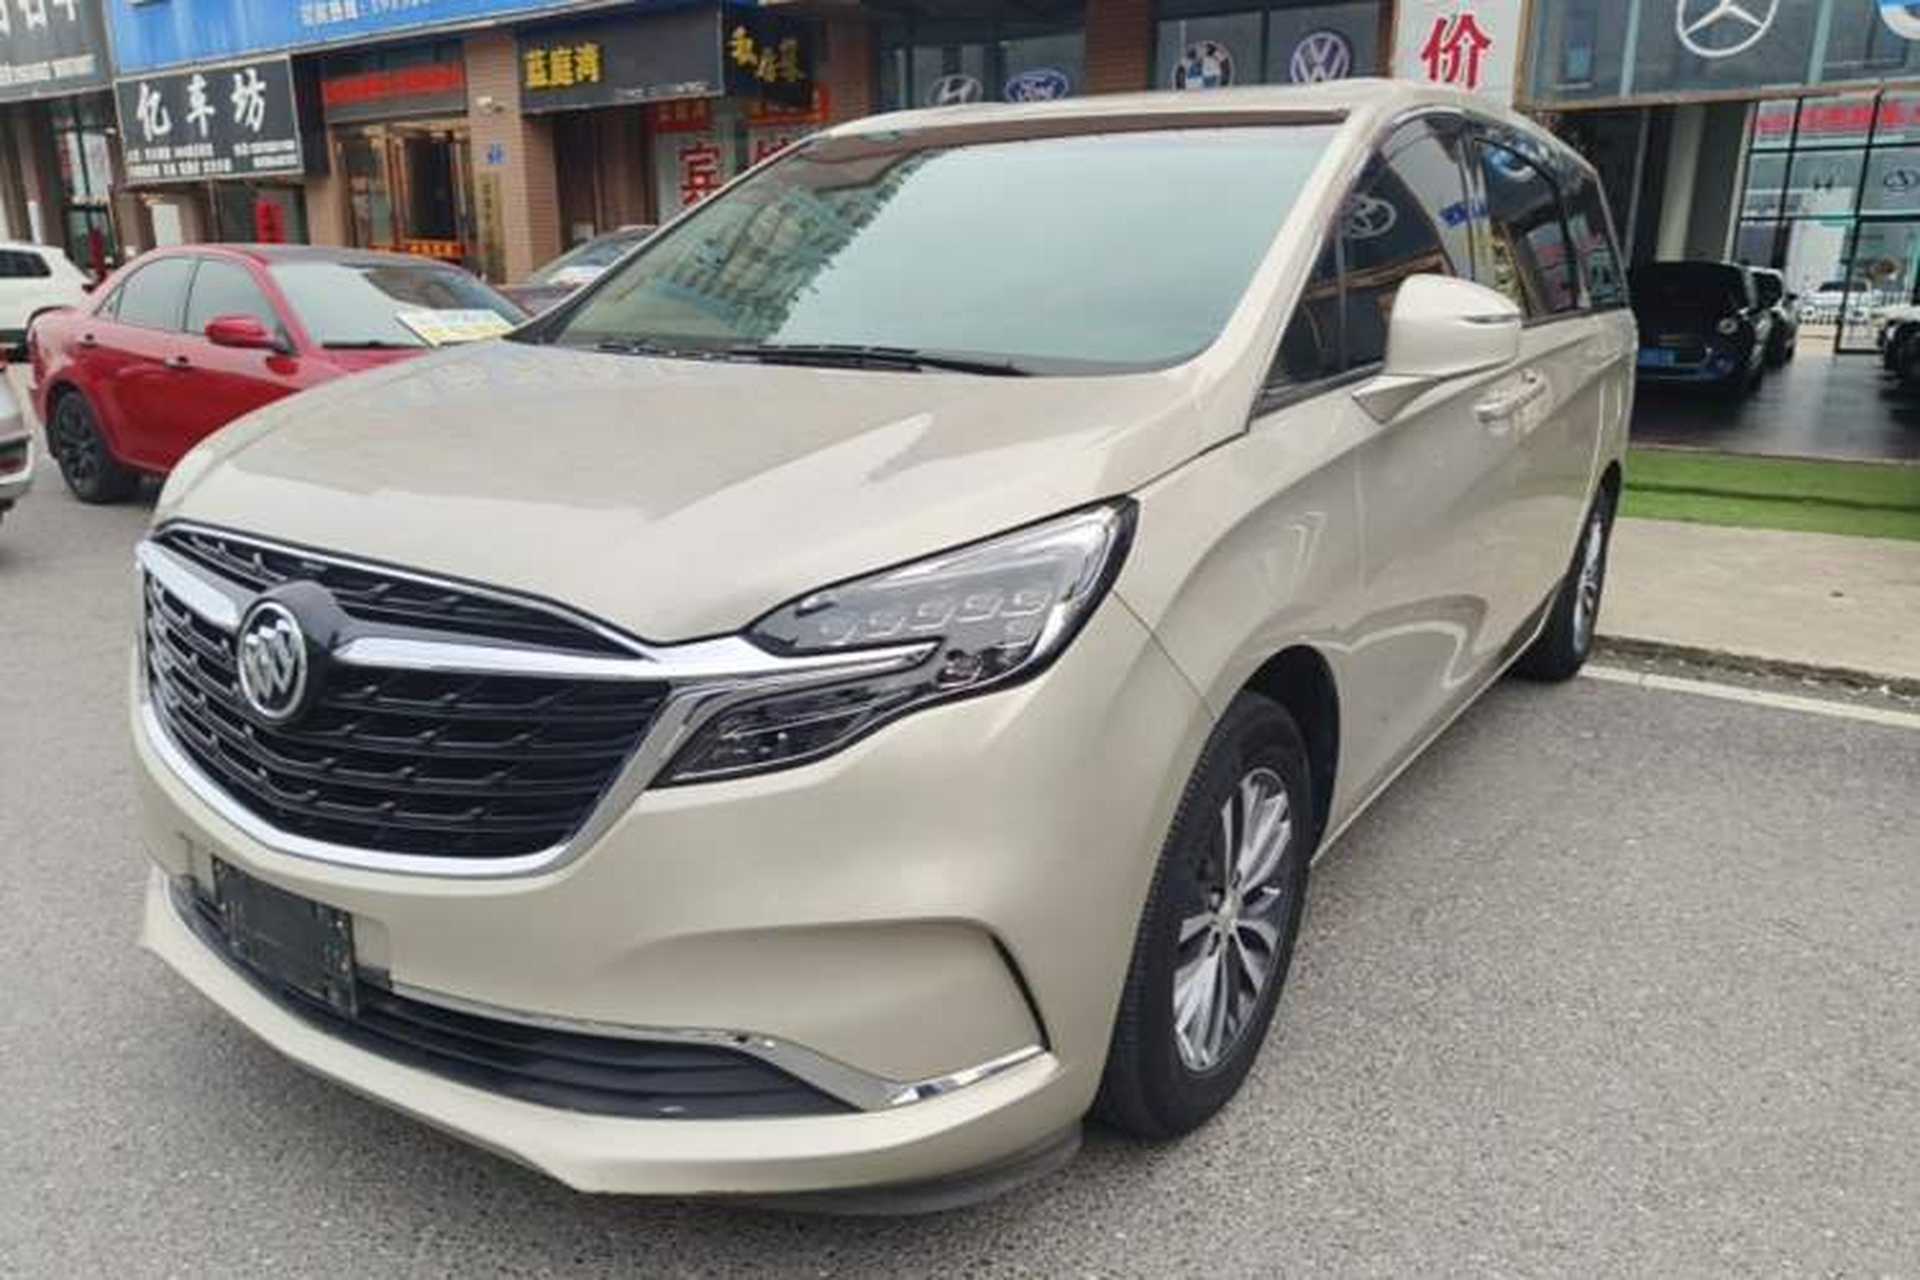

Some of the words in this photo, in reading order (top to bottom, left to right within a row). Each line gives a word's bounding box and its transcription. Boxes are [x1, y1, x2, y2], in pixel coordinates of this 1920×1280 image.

[1421, 13, 1491, 90] 价
[137, 67, 267, 141] 亿车坊
